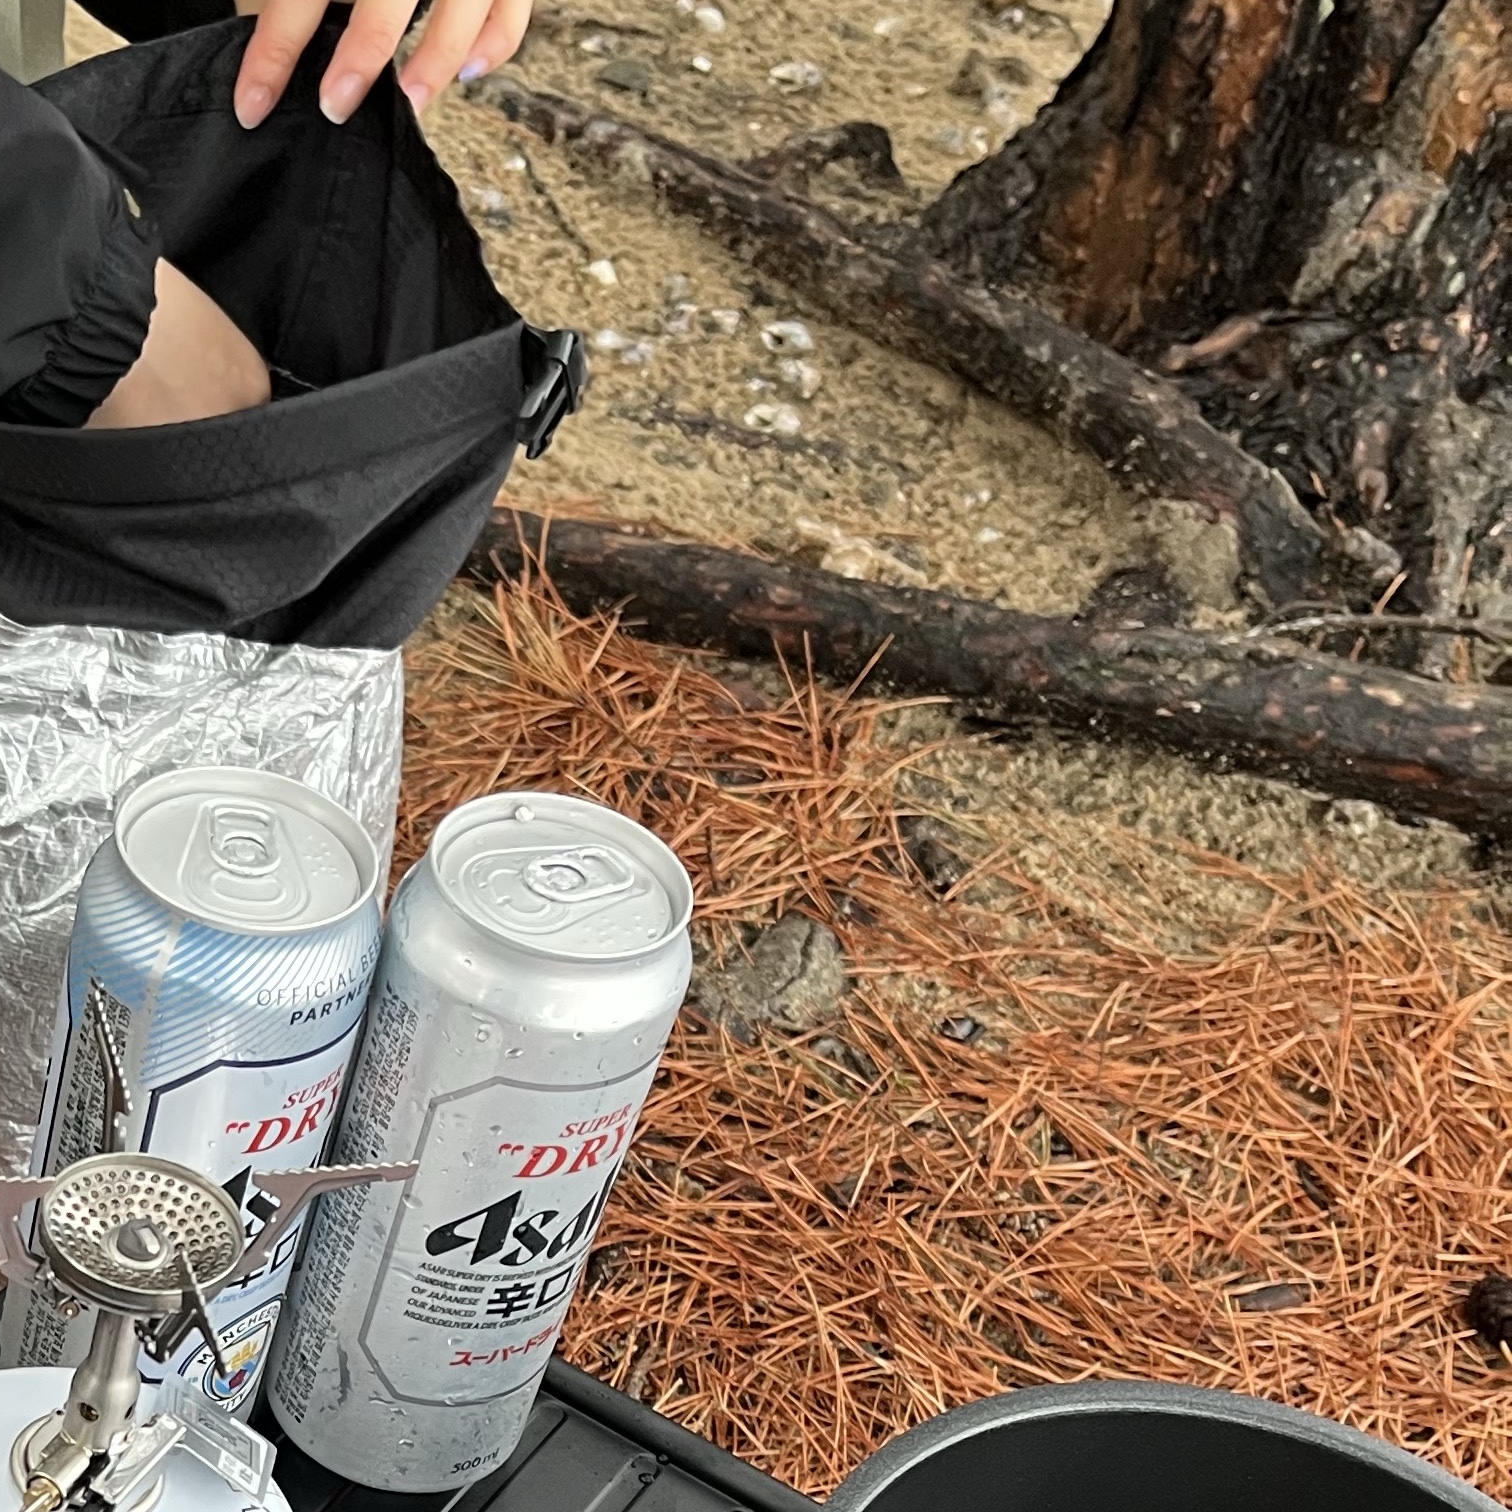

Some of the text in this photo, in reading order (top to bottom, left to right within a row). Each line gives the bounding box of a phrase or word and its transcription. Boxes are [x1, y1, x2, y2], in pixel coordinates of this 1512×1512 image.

[257, 967, 358, 1007] OFFICIAL
[559, 1103, 632, 1138] SUPER
[486, 1262, 576, 1319] 辛口
[450, 1446, 500, 1475] 500 ml
